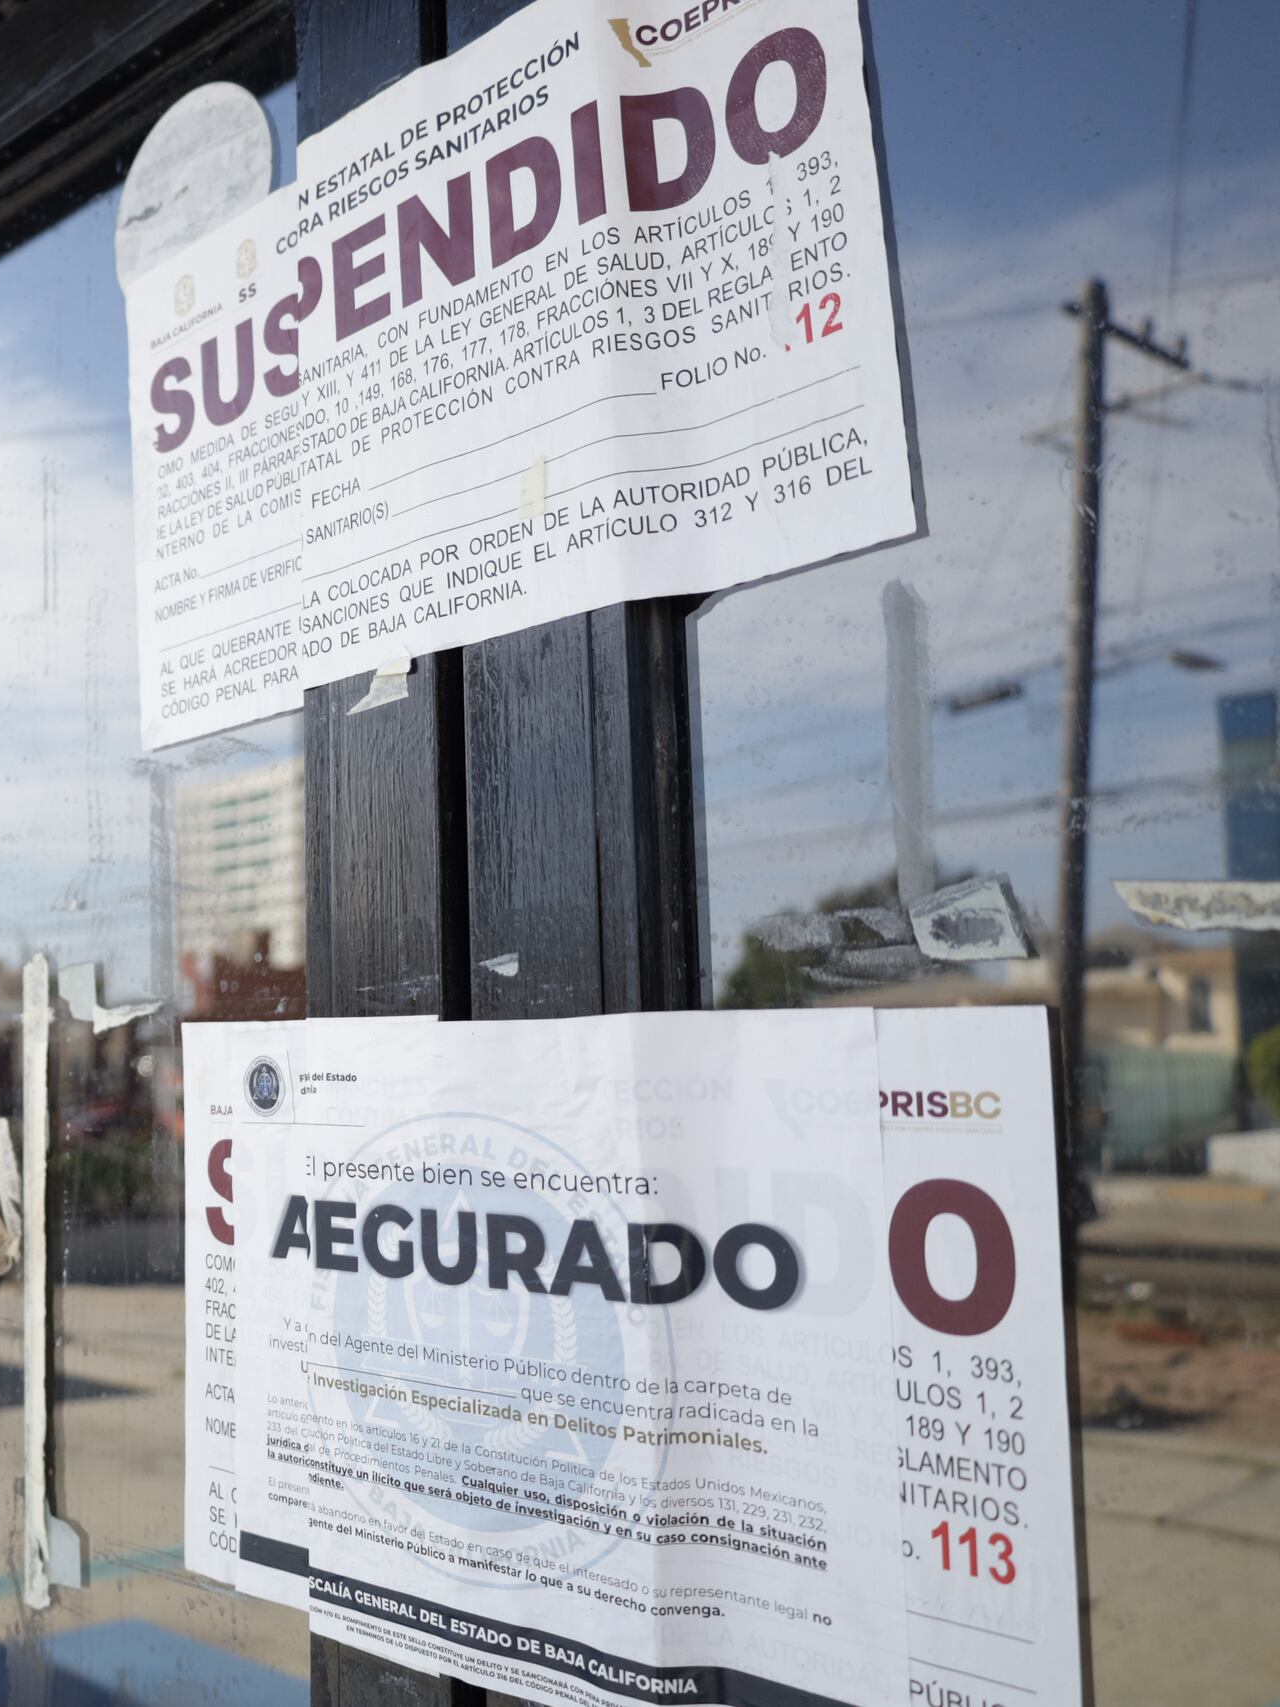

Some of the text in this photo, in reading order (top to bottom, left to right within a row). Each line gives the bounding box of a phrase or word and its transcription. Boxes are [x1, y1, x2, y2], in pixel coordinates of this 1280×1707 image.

[315, 31, 580, 200] ESTATAL DE PROTECCIÓN
[328, 85, 549, 221] RIESGOS SANITARIOS
[377, 151, 839, 349] CON FUNDAMENTO EN LOS ARTÍCULOS 393,
[238, 282, 257, 304] SS
[317, 175, 842, 403] XIII, Y 411 DE LA LEY GENERAL DE SALUD, 2
[335, 202, 845, 417] 10 168, 176, 177, 178, FRACCIÓNES VII Y X, Y 190
[150, 302, 223, 350] BAJA CALIFORNIA
[661, 292, 844, 390] FOLIO No. 12
[350, 296, 703, 434] DE BAJA CALIFORNIA. ARTÍCULOS 1, 3 DEL
[351, 326, 696, 456] DE PROTECCIÓN CONTRA RIESGOS
[190, 402, 299, 466] MEDIDA DE SEGU
[184, 482, 264, 533] LEY DE SALUD
[212, 488, 302, 540] DE LA COMIS
[306, 500, 390, 545] SANITARIO(S)
[311, 477, 361, 509] FECHA
[327, 427, 869, 602] COLOCADA POR ORDEN DE LA AUTORIDAD PÚBLICA,
[302, 456, 873, 635] SANCIONES QUE INDIQUE EL ARTÍCULO 312 Y 316 DEL
[154, 570, 183, 594] ACTA
[155, 594, 197, 623] NOMBRE
[208, 580, 241, 604] FIRMA
[243, 572, 258, 591] DE
[340, 579, 527, 649] DE BAJA CALIFORNIA.
[160, 619, 291, 677] AL QUE QUEBRANTE
[161, 642, 298, 698] SE HARÁ ACREEDOR
[161, 665, 299, 719] CÓDIGO PENAL PARA
[326, 1072, 357, 1082] Estado
[323, 1159, 659, 1197] presente bien se encuentra:
[271, 1193, 802, 1311] AEGURADO
[205, 1299, 236, 1320] FRAC
[205, 1383, 235, 1403] ACTA
[320, 1331, 760, 1402] del Agente del Ministerio Público dentro carpeta
[932, 1350, 1022, 1389] 1, 393,
[313, 1372, 768, 1455] Investigación Especializada en Delitos Patrimoniales.
[521, 1386, 764, 1428] que encuentra radicada
[896, 1378, 1024, 1420] ULOS 1, 2
[906, 1414, 1025, 1456] 189 Y 190
[461, 1475, 827, 1551] Cualquier disposición violación situación
[515, 1502, 828, 1571] investigación consignación ante
[931, 1520, 1017, 1585] 113
[458, 1556, 725, 1619] manifestar convenga.
[355, 1590, 698, 1694] GENERAL DEL ESTADO DE BAJA CALIFORNIA
